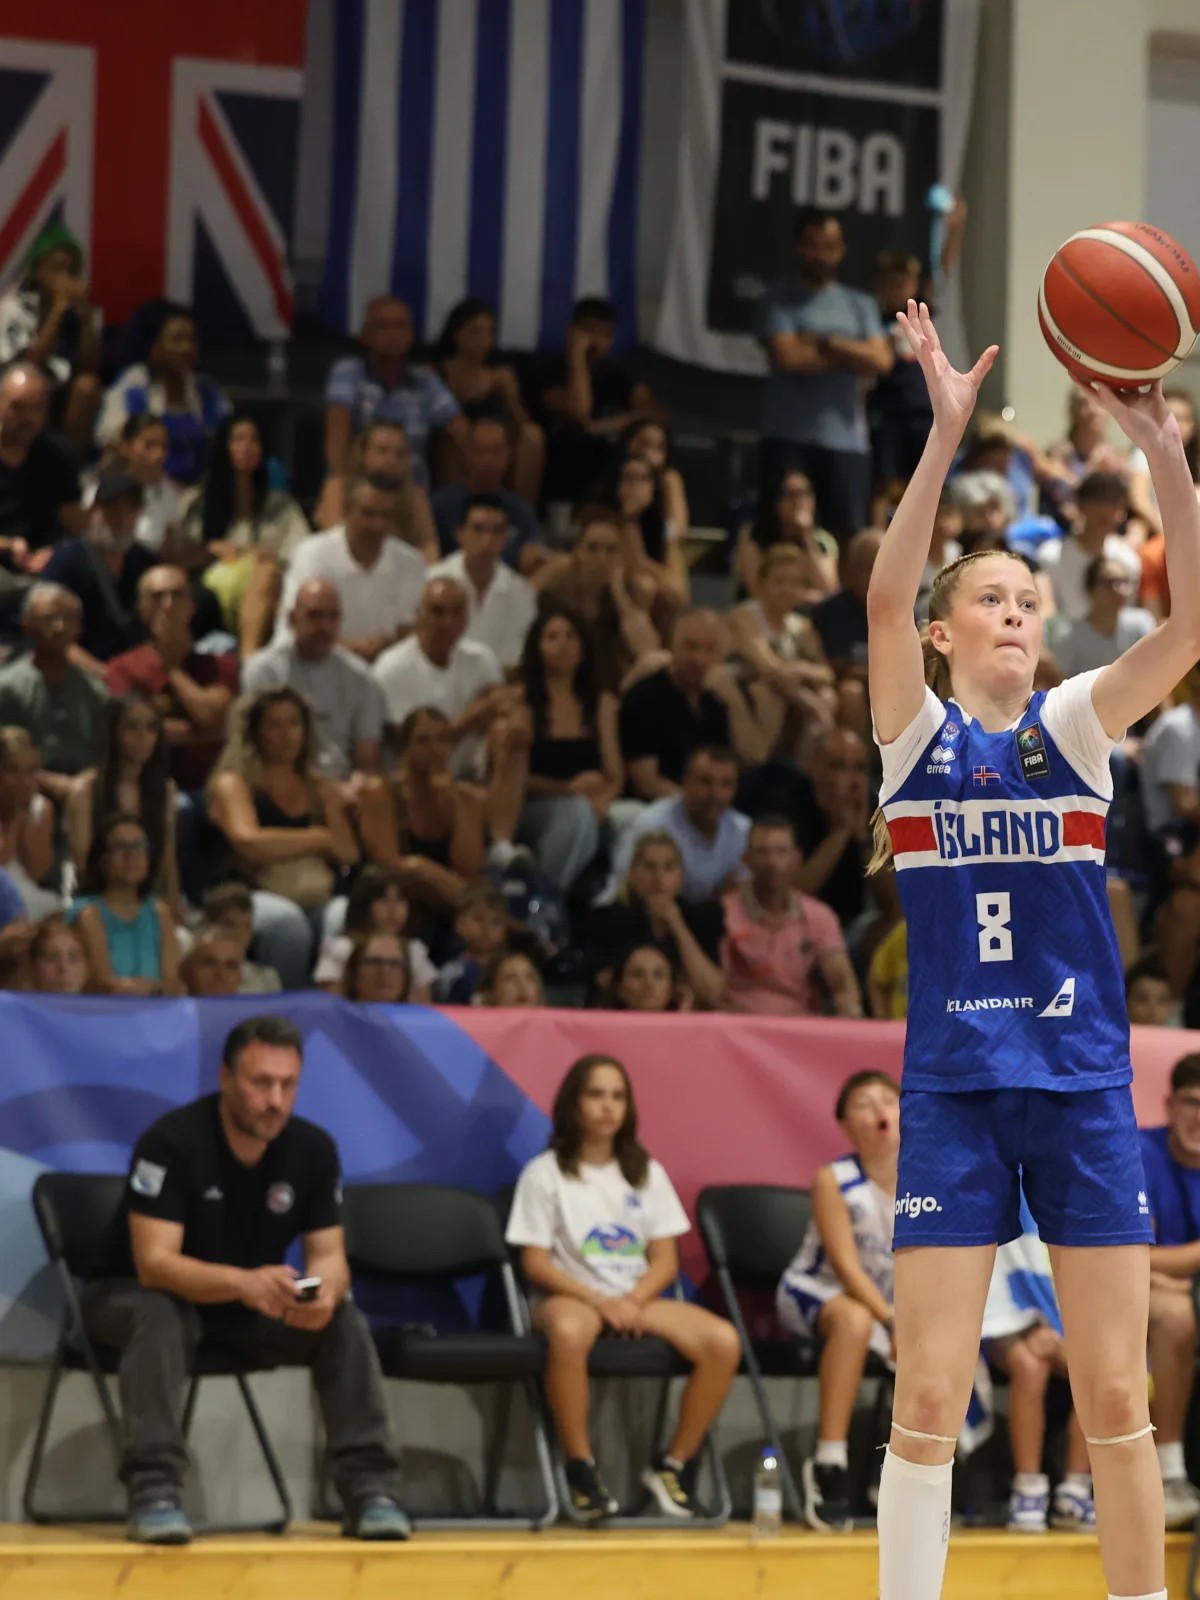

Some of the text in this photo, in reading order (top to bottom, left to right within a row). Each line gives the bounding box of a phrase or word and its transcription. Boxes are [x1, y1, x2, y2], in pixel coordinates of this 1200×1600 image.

[753, 117, 905, 217] FIBA
[1024, 753, 1044, 767] FIBA
[934, 801, 1061, 859] ÍSLAND
[976, 891, 1013, 962] 8
[895, 1191, 943, 1219] origo.
